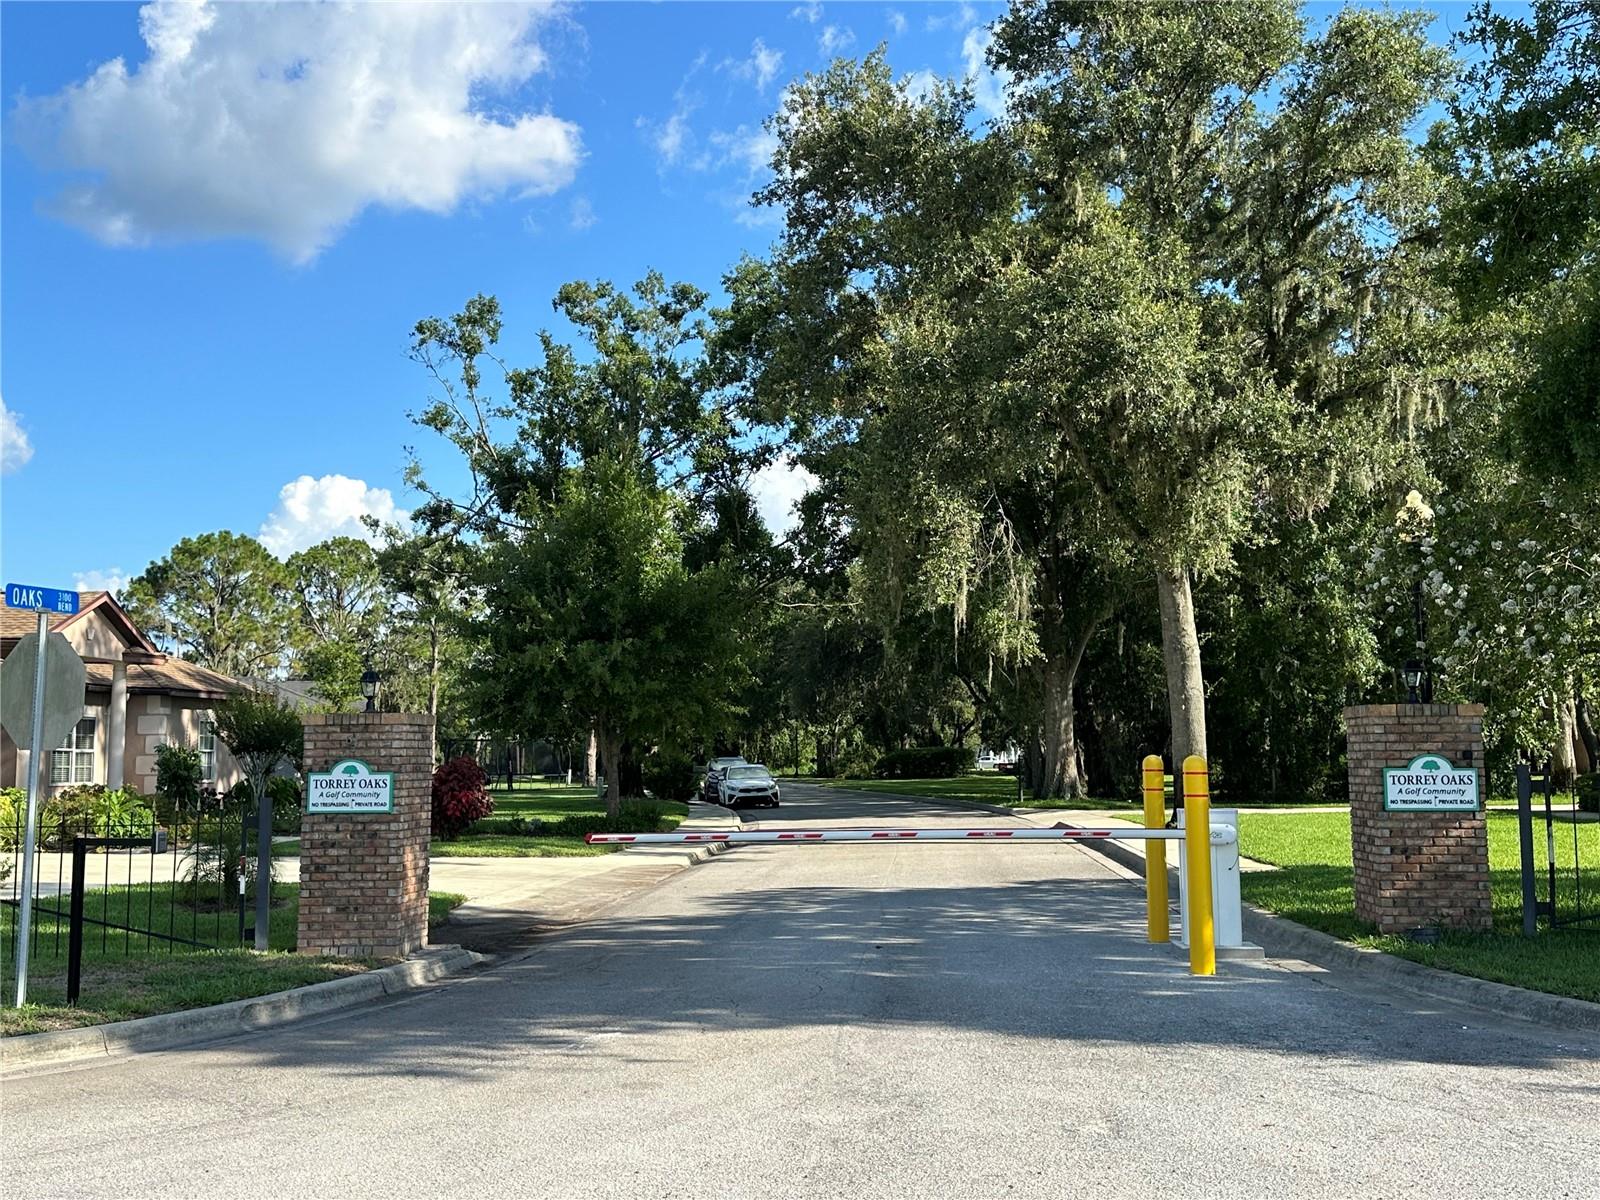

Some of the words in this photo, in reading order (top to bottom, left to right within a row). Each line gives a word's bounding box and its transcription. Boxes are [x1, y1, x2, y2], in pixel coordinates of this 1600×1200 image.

[12, 587, 43, 607] OAKS
[57, 592, 72, 602] 3100
[57, 601, 73, 612] BEND
[313, 779, 357, 789] TORREY
[359, 778, 388, 789] OAKS
[1389, 774, 1438, 786] TORREY
[1441, 774, 1474, 786] OAKS
[325, 791, 340, 799] Golf
[341, 791, 381, 799] Community
[1405, 787, 1421, 796] Golf
[1422, 787, 1466, 796] Community
